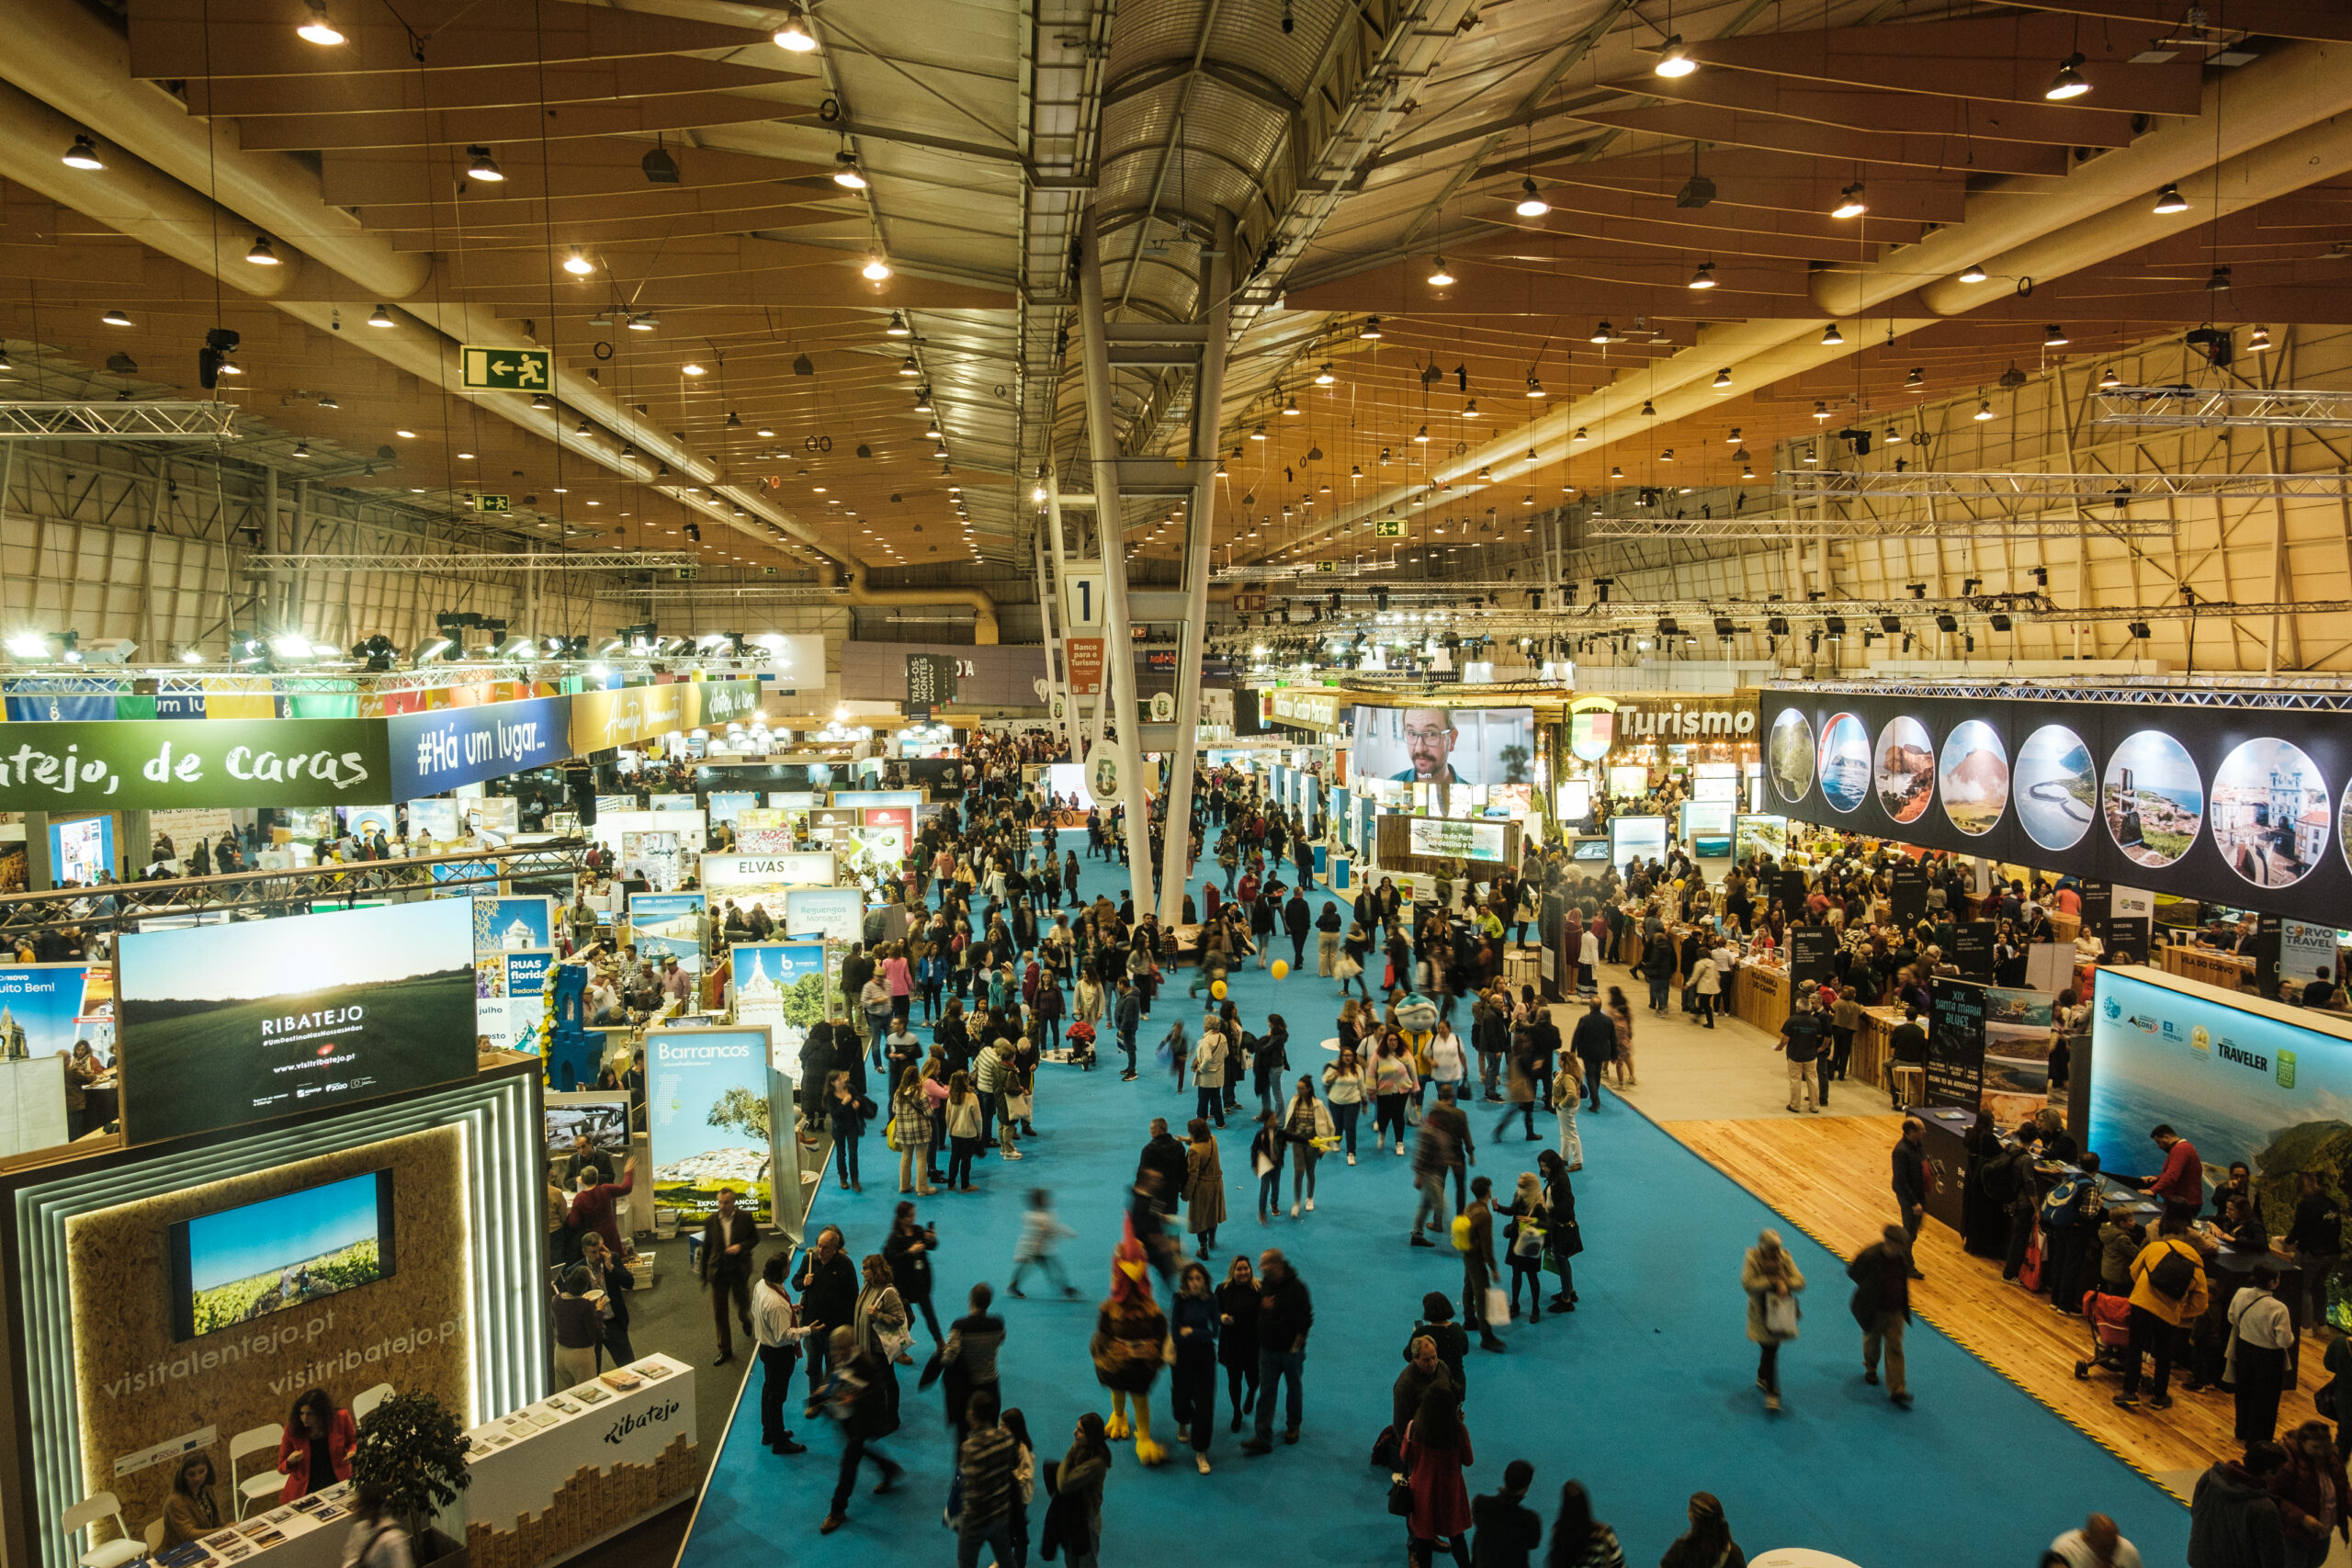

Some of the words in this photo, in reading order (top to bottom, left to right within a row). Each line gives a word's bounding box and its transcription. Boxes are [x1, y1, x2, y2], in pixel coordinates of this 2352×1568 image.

[1077, 581, 1091, 621] 1
[1274, 693, 1293, 718] Turismo
[1617, 703, 1755, 735] Turismo
[417, 722, 458, 776] #Há
[465, 730, 492, 765] um
[497, 720, 546, 761] lugar...
[143, 741, 203, 783] de
[225, 746, 368, 790] Caras
[739, 861, 785, 874] ELVAS
[801, 907, 846, 917] Reguengos
[2285, 935, 2333, 948] TRAVEL
[511, 960, 542, 969] RUAS
[2181, 955, 2196, 964] VILA
[2197, 959, 2207, 969] DO
[2209, 963, 2233, 975] CORVO
[25, 982, 55, 993] Bem!
[1952, 990, 1965, 1002] XIX
[479, 1007, 503, 1015] julho
[1935, 999, 1956, 1010] SANTA
[1958, 1003, 1982, 1017] MARIA
[262, 1005, 364, 1036] RIBATEJO
[1945, 1012, 1969, 1027] BLUES
[2163, 1032, 2183, 1043] unesco
[658, 1043, 750, 1060] Barrancos
[2217, 1043, 2268, 1073] TRAVELER
[274, 1053, 356, 1074] www.visitribatejo.pt
[103, 1309, 335, 1400] visitalentejo.pt
[268, 1314, 466, 1397] visitribatejo.pt
[604, 1398, 679, 1445] Ribatejo
